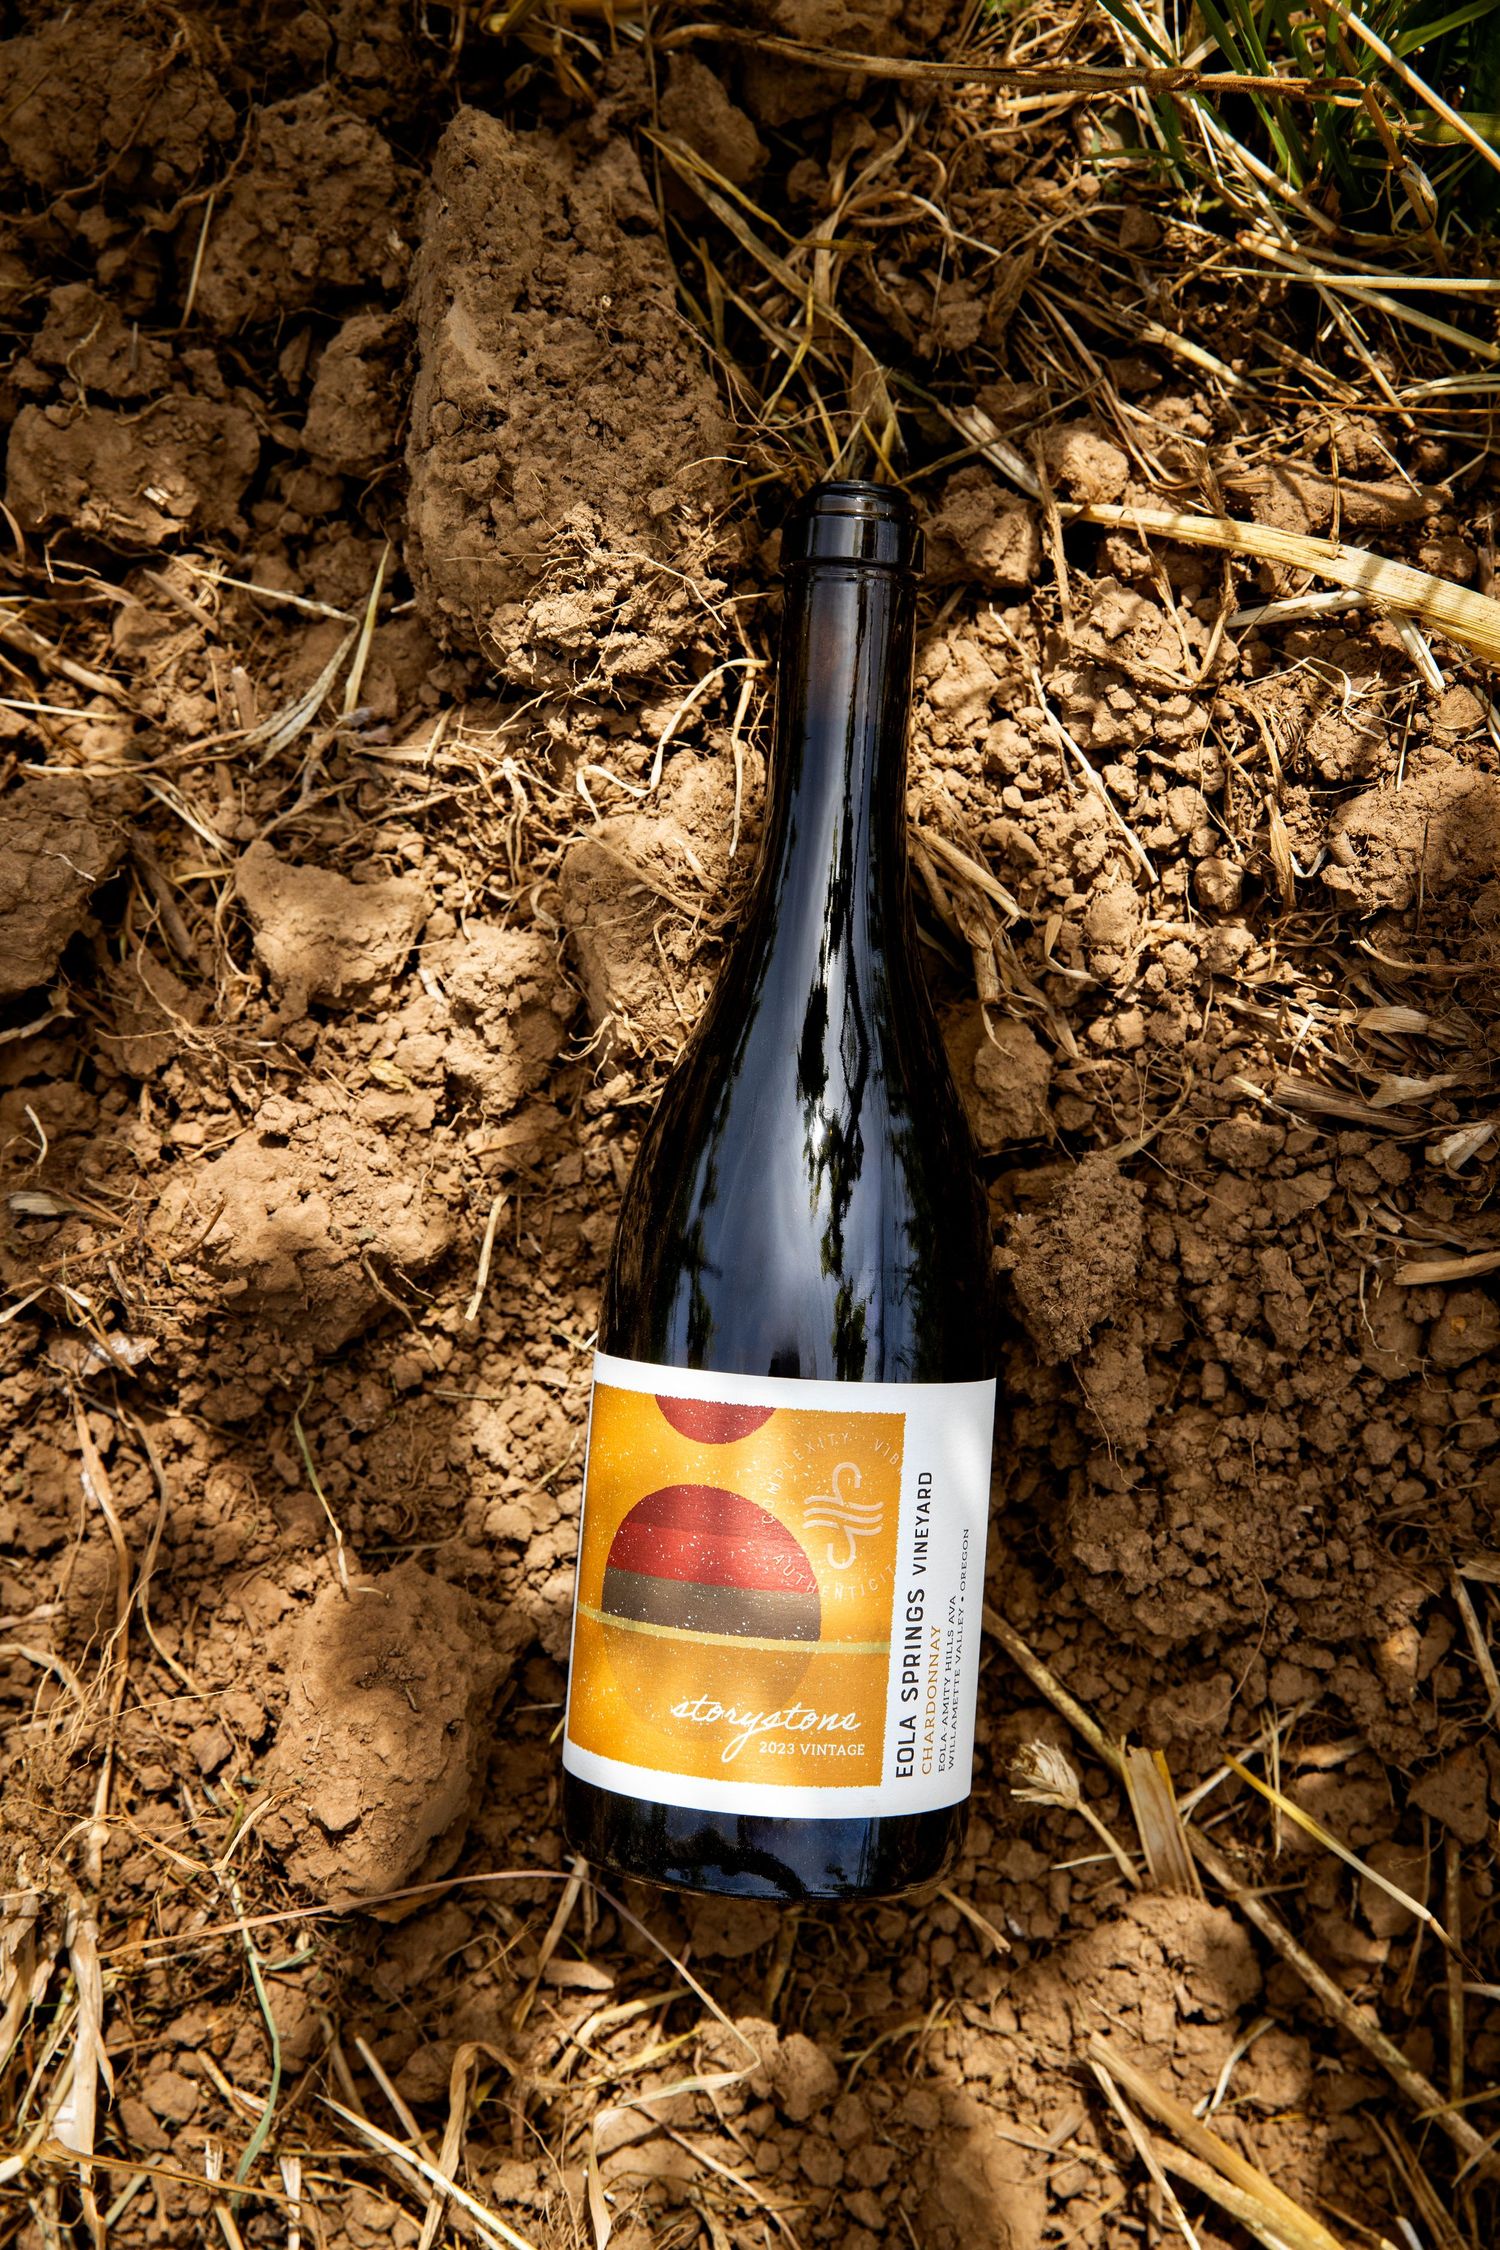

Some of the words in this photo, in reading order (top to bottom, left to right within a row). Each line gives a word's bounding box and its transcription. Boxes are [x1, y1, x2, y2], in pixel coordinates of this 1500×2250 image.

[761, 1432, 850, 1525] COMPLEXITY
[874, 1439, 902, 1470] VIB
[913, 1472, 933, 1576] VINEYARD
[960, 1528, 969, 1591] OREGON
[901, 1588, 925, 1702] SPRINGS
[948, 1596, 957, 1625] AVA
[956, 1608, 965, 1664] VALLEY
[945, 1629, 955, 1671] HILLS
[671, 1694, 861, 1763] storystone
[922, 1626, 941, 1775] CHARDONNAY
[938, 1678, 951, 1772] EOLA-AMITY
[948, 1669, 961, 1770] WILLAMETTE
[759, 1742, 795, 1756] 2023
[799, 1743, 866, 1756] VINTAGE
[896, 1715, 917, 1778] EOLA
